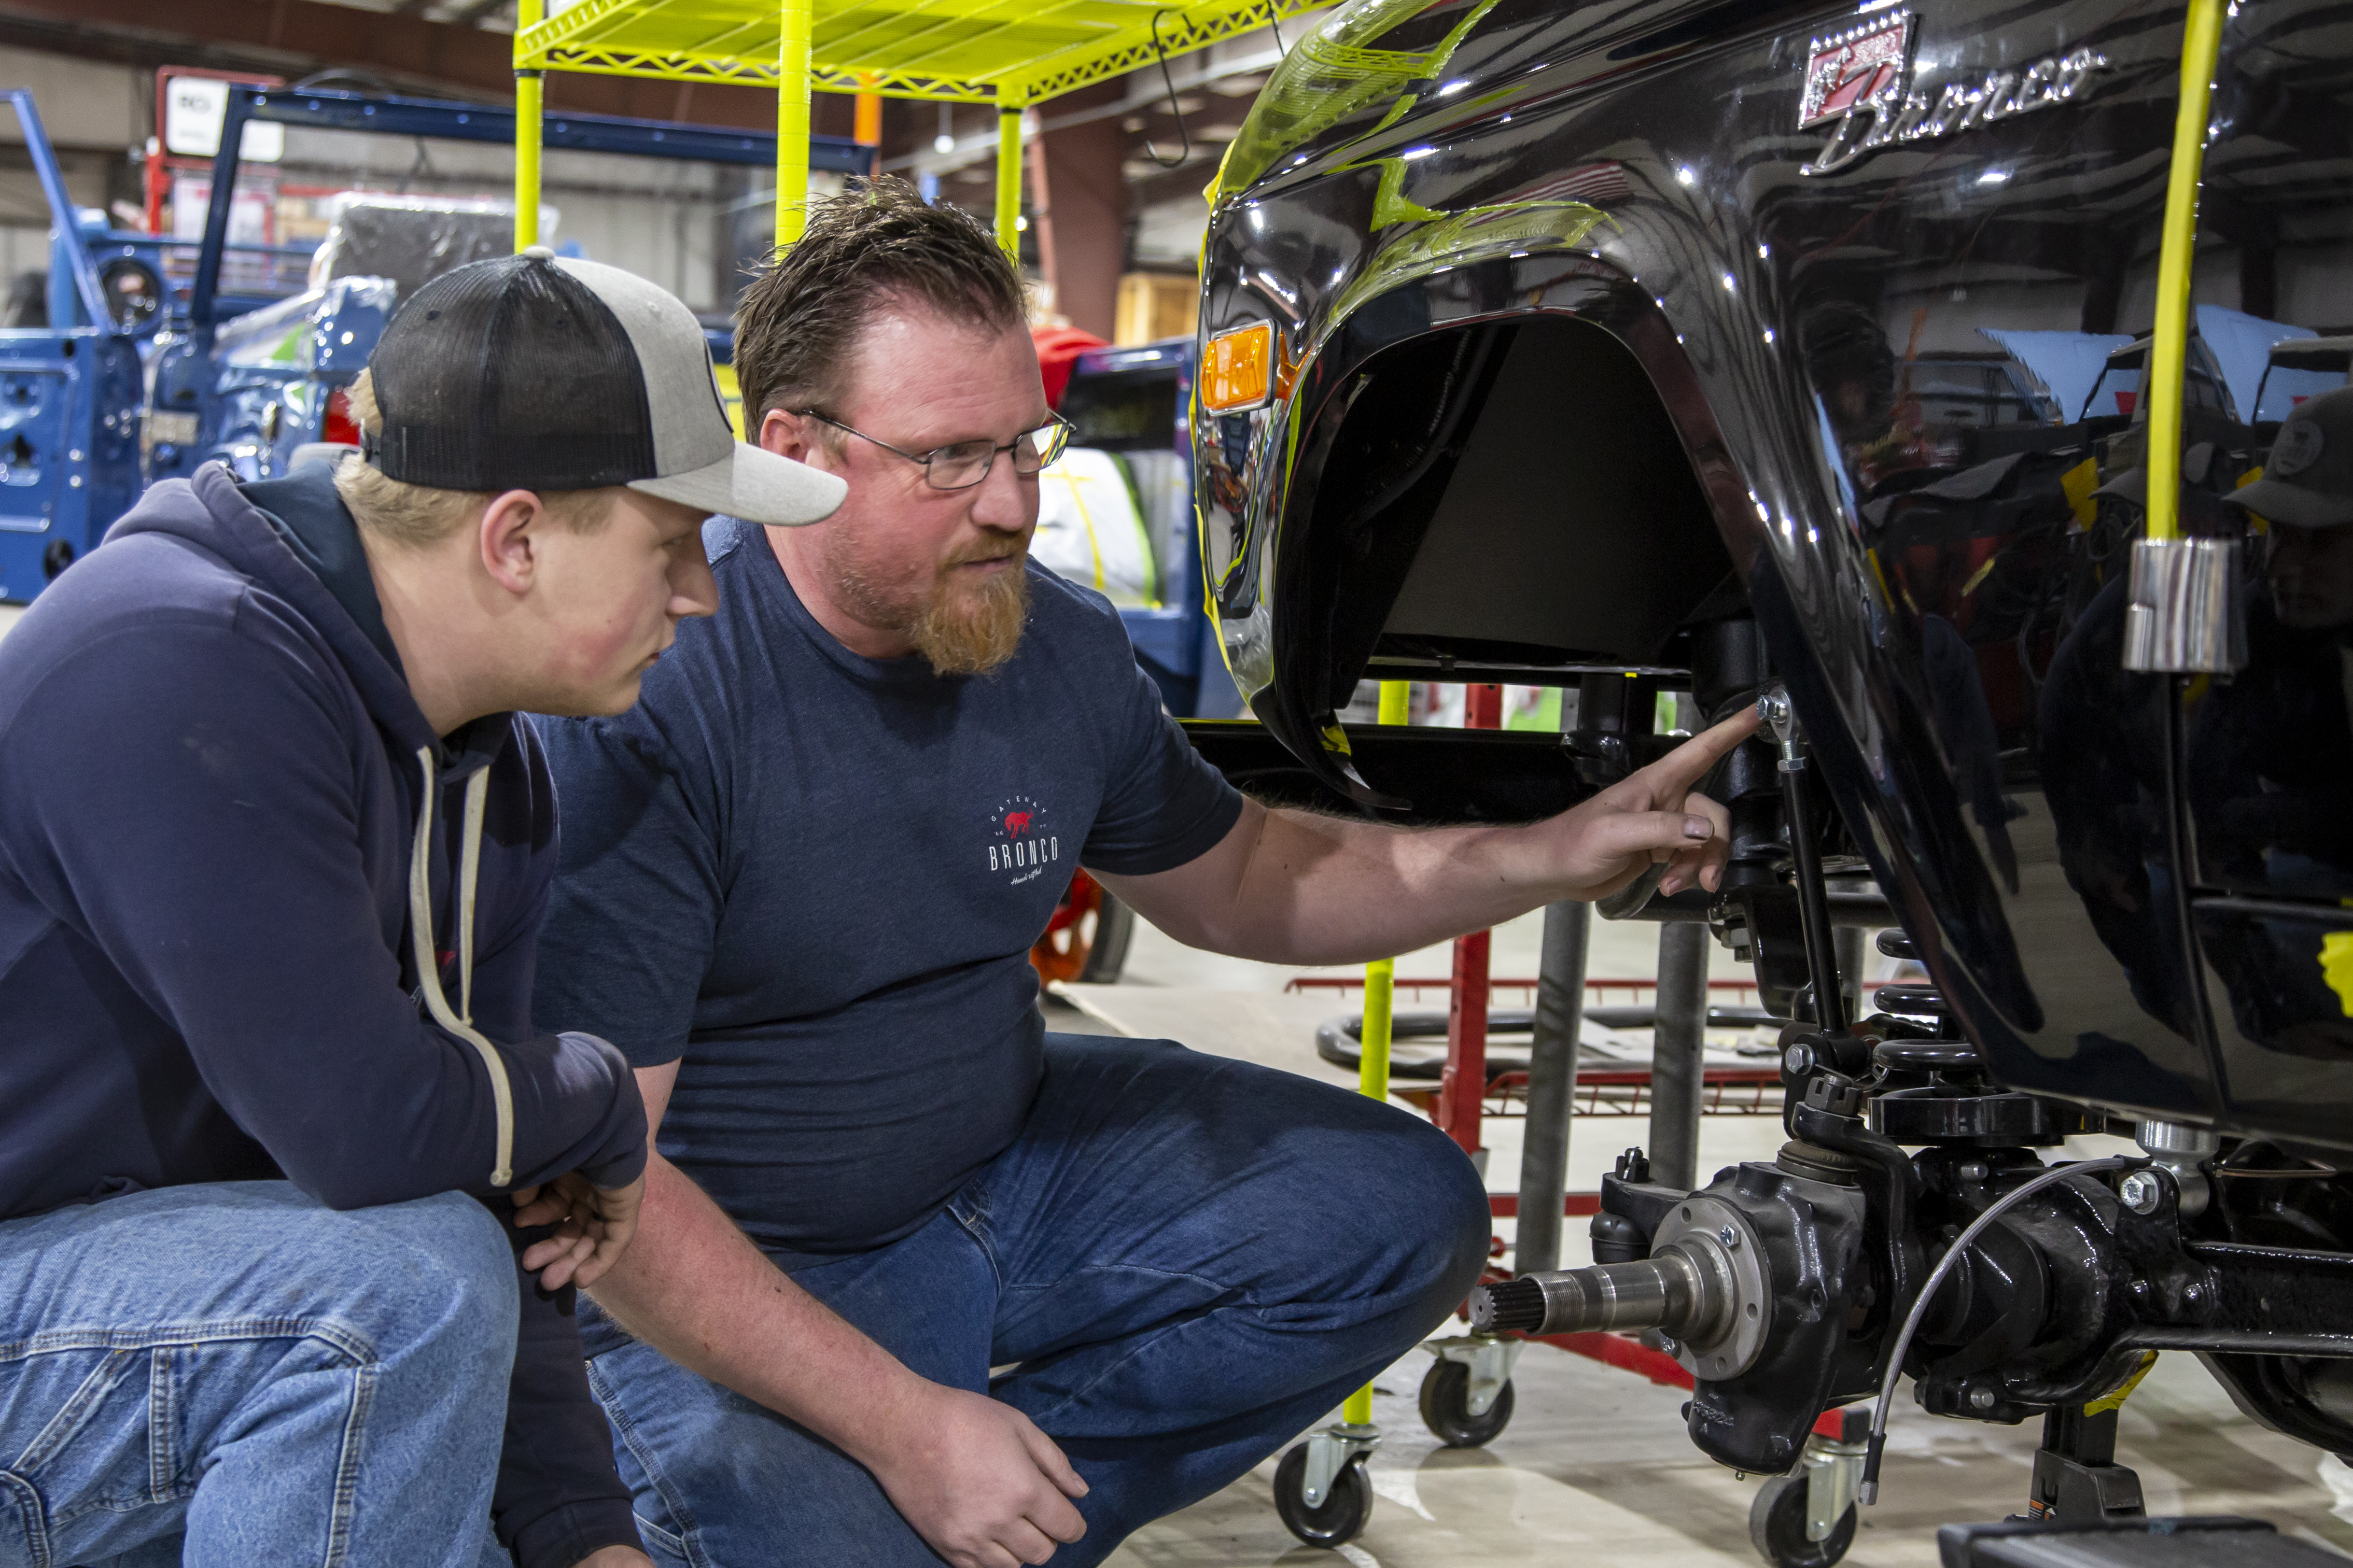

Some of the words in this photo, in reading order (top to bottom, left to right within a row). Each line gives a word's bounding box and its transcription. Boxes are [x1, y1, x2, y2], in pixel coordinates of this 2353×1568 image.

[1799, 48, 2108, 175] Bronco
[991, 796, 1046, 822] GATEWAY
[989, 836, 1058, 871] BRONCO
[1010, 865, 1042, 886] Handcrafted
